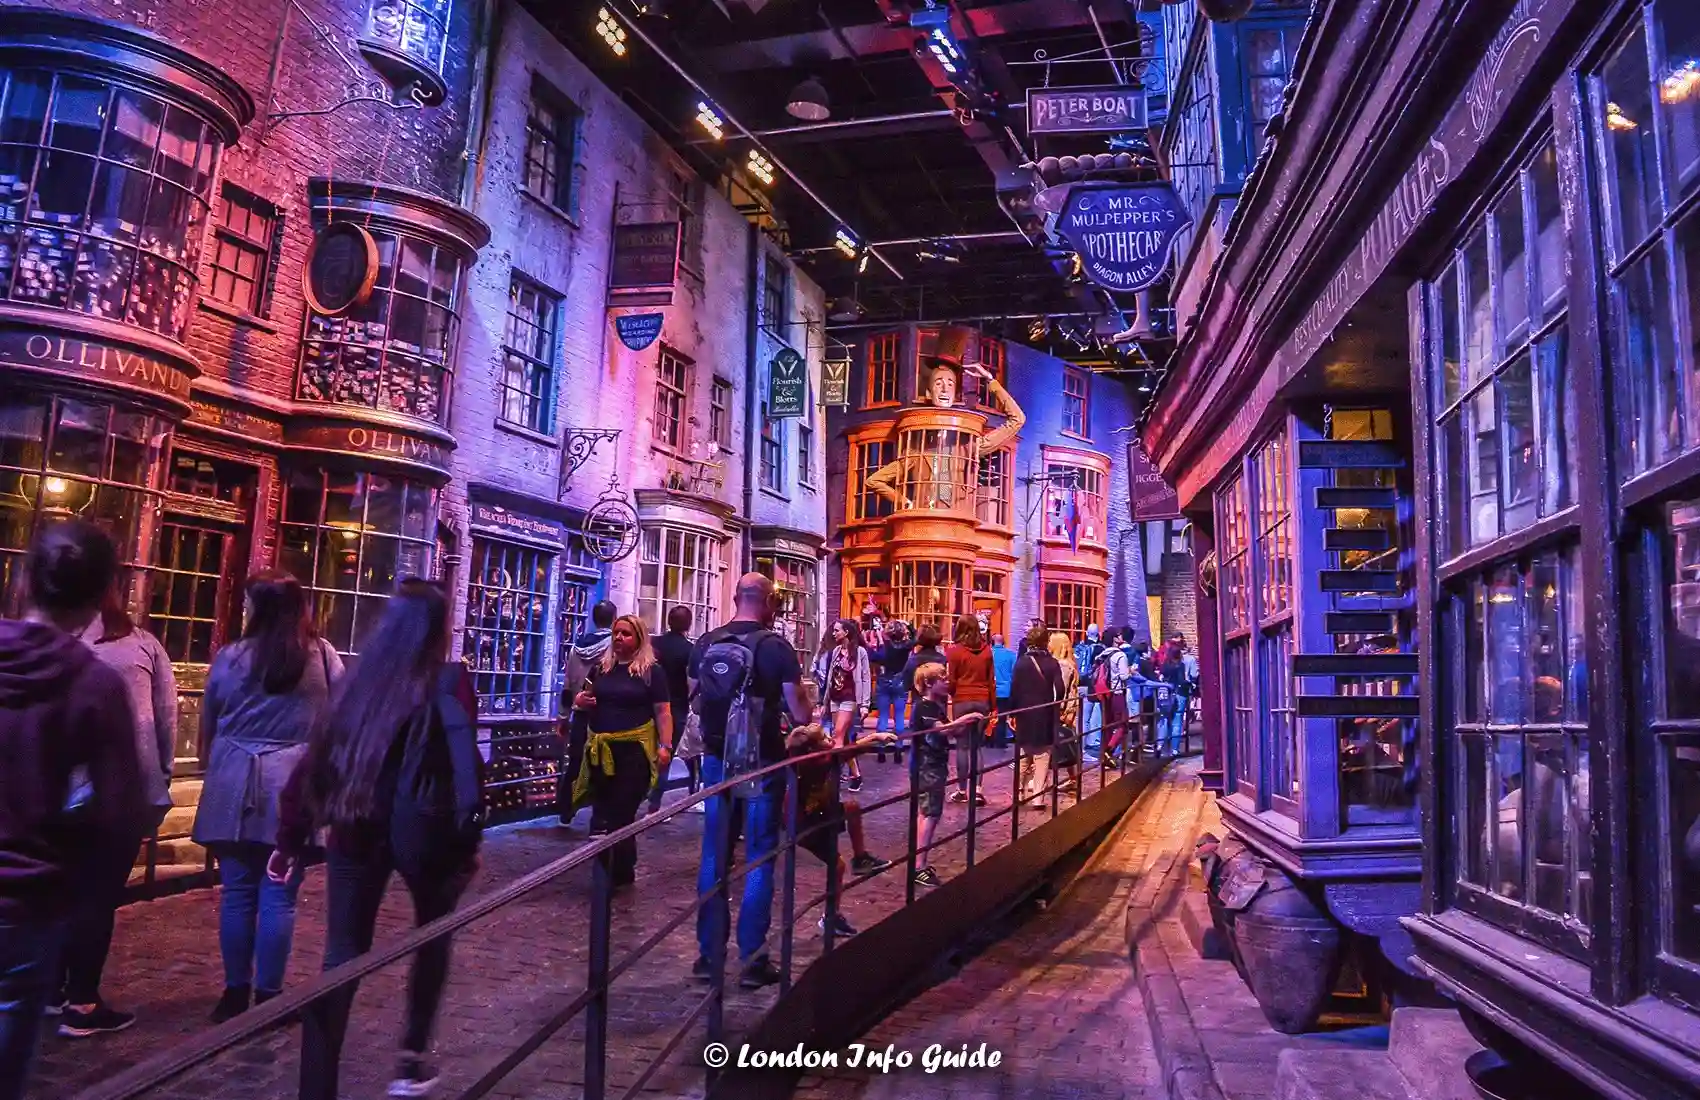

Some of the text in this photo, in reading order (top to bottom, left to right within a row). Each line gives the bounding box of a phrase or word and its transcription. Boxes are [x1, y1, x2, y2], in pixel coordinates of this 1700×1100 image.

[1036, 96, 1141, 126] PETER BOAT
[1108, 196, 1138, 210] MR.
[1071, 209, 1176, 227] MULPEPPER'S
[1092, 261, 1124, 285] DIAGON
